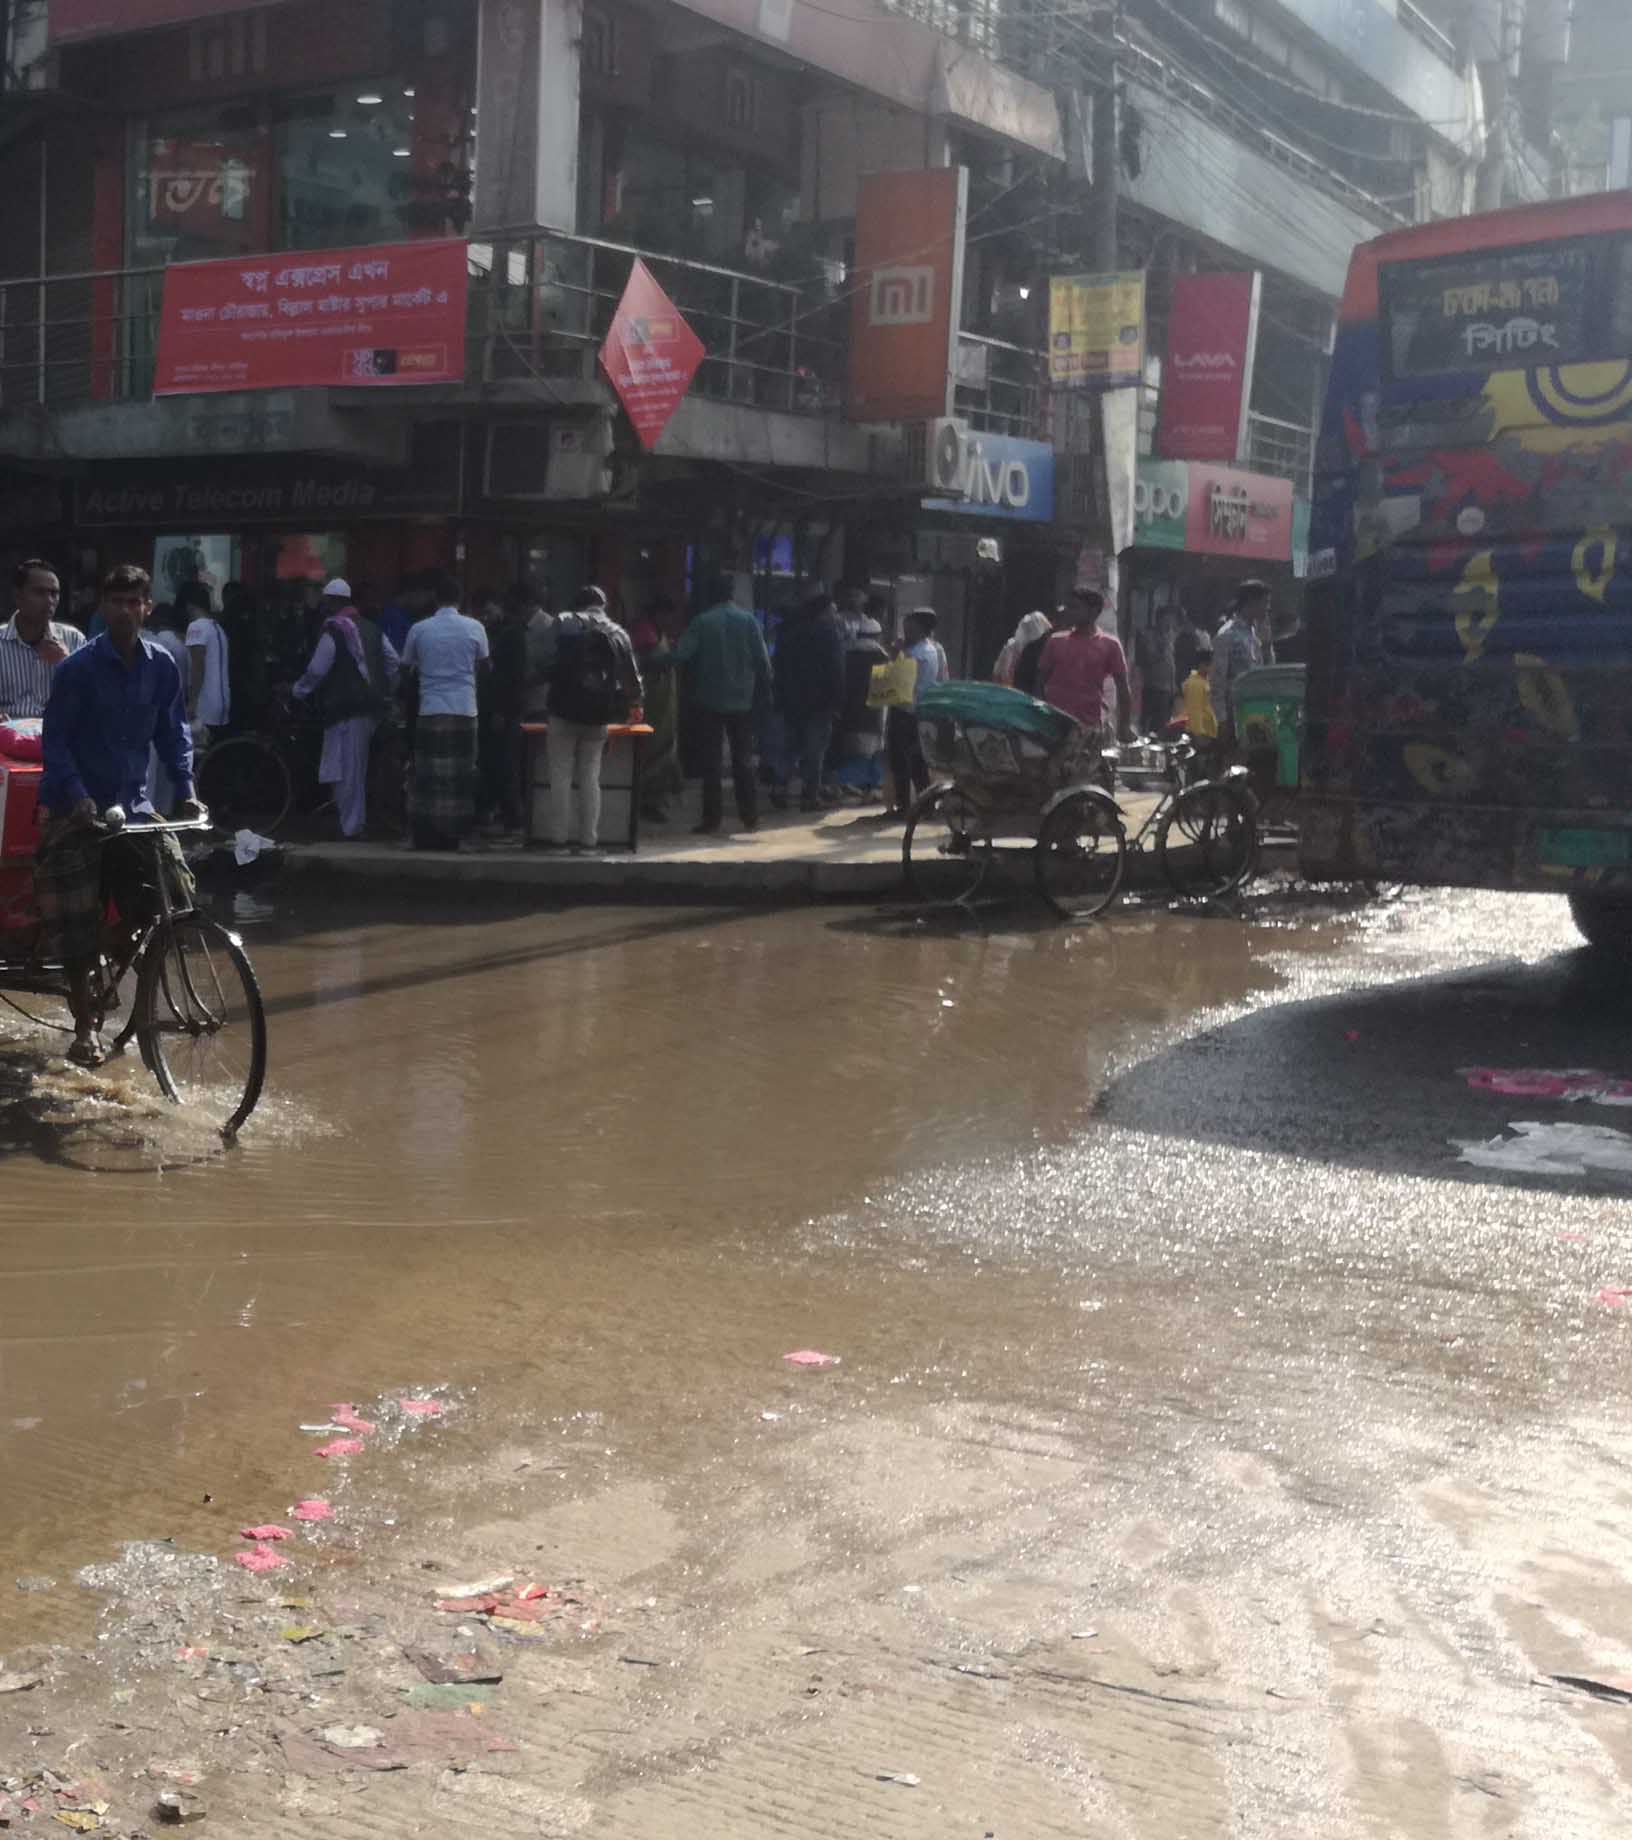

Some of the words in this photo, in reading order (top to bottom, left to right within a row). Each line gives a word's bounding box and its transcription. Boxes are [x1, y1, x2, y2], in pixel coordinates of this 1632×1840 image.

[1173, 352, 1236, 369] LAVA
[84, 485, 164, 514] Active
[172, 481, 282, 512] Telecom
[289, 477, 377, 508] Media
